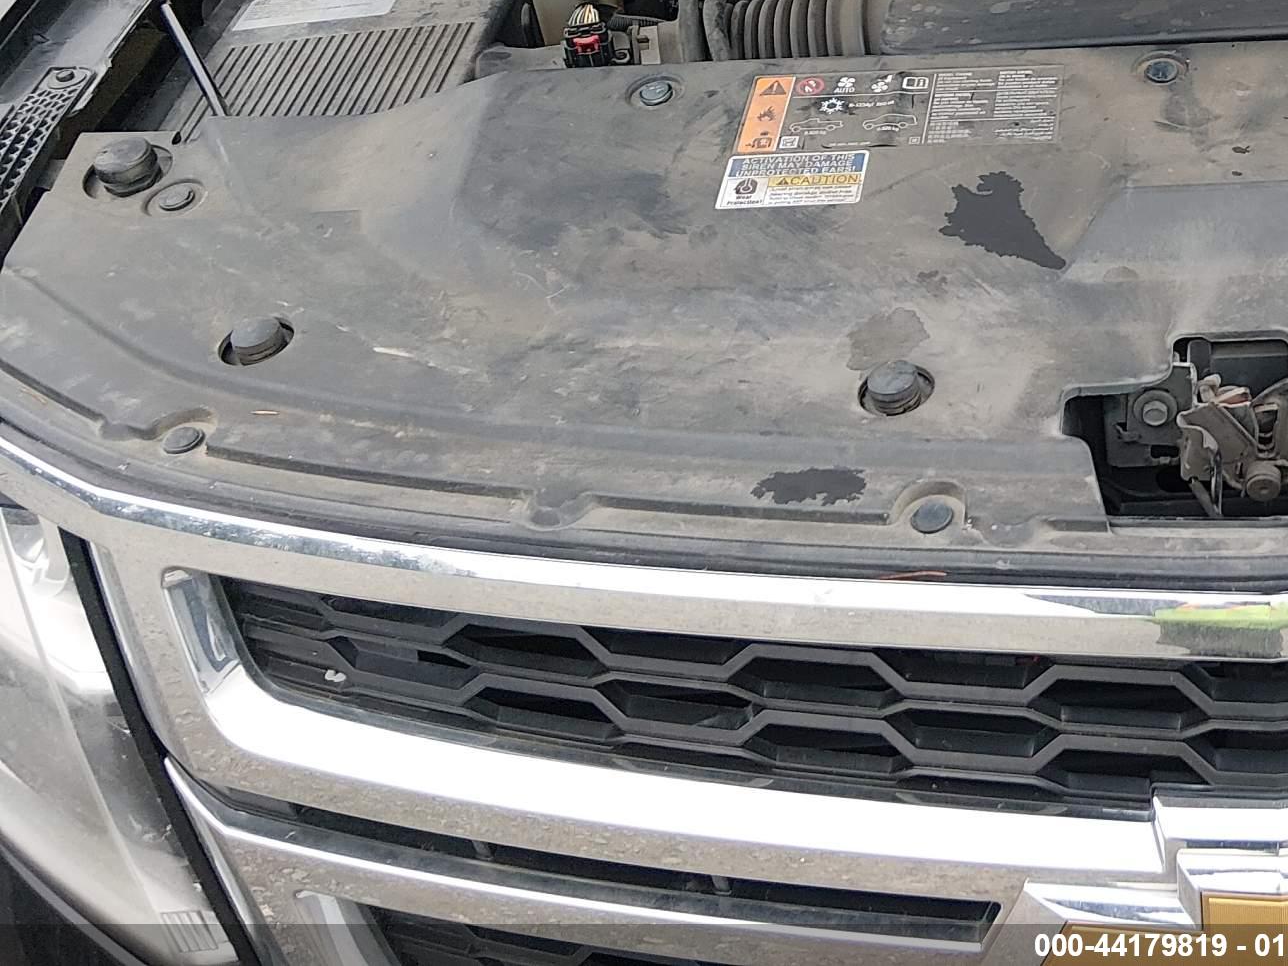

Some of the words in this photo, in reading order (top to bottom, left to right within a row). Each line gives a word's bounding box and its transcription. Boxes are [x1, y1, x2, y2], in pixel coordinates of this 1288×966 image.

[743, 154, 809, 165] ACTIVATION
[812, 154, 829, 162] OF
[831, 153, 855, 161] THIS
[735, 168, 819, 177] UNPROTECTED
[821, 166, 856, 174] EARS!
[742, 163, 777, 172] SIREN
[777, 162, 803, 170] MAY
[804, 160, 854, 168] DAMAGE
[790, 174, 859, 185] CAUTION
